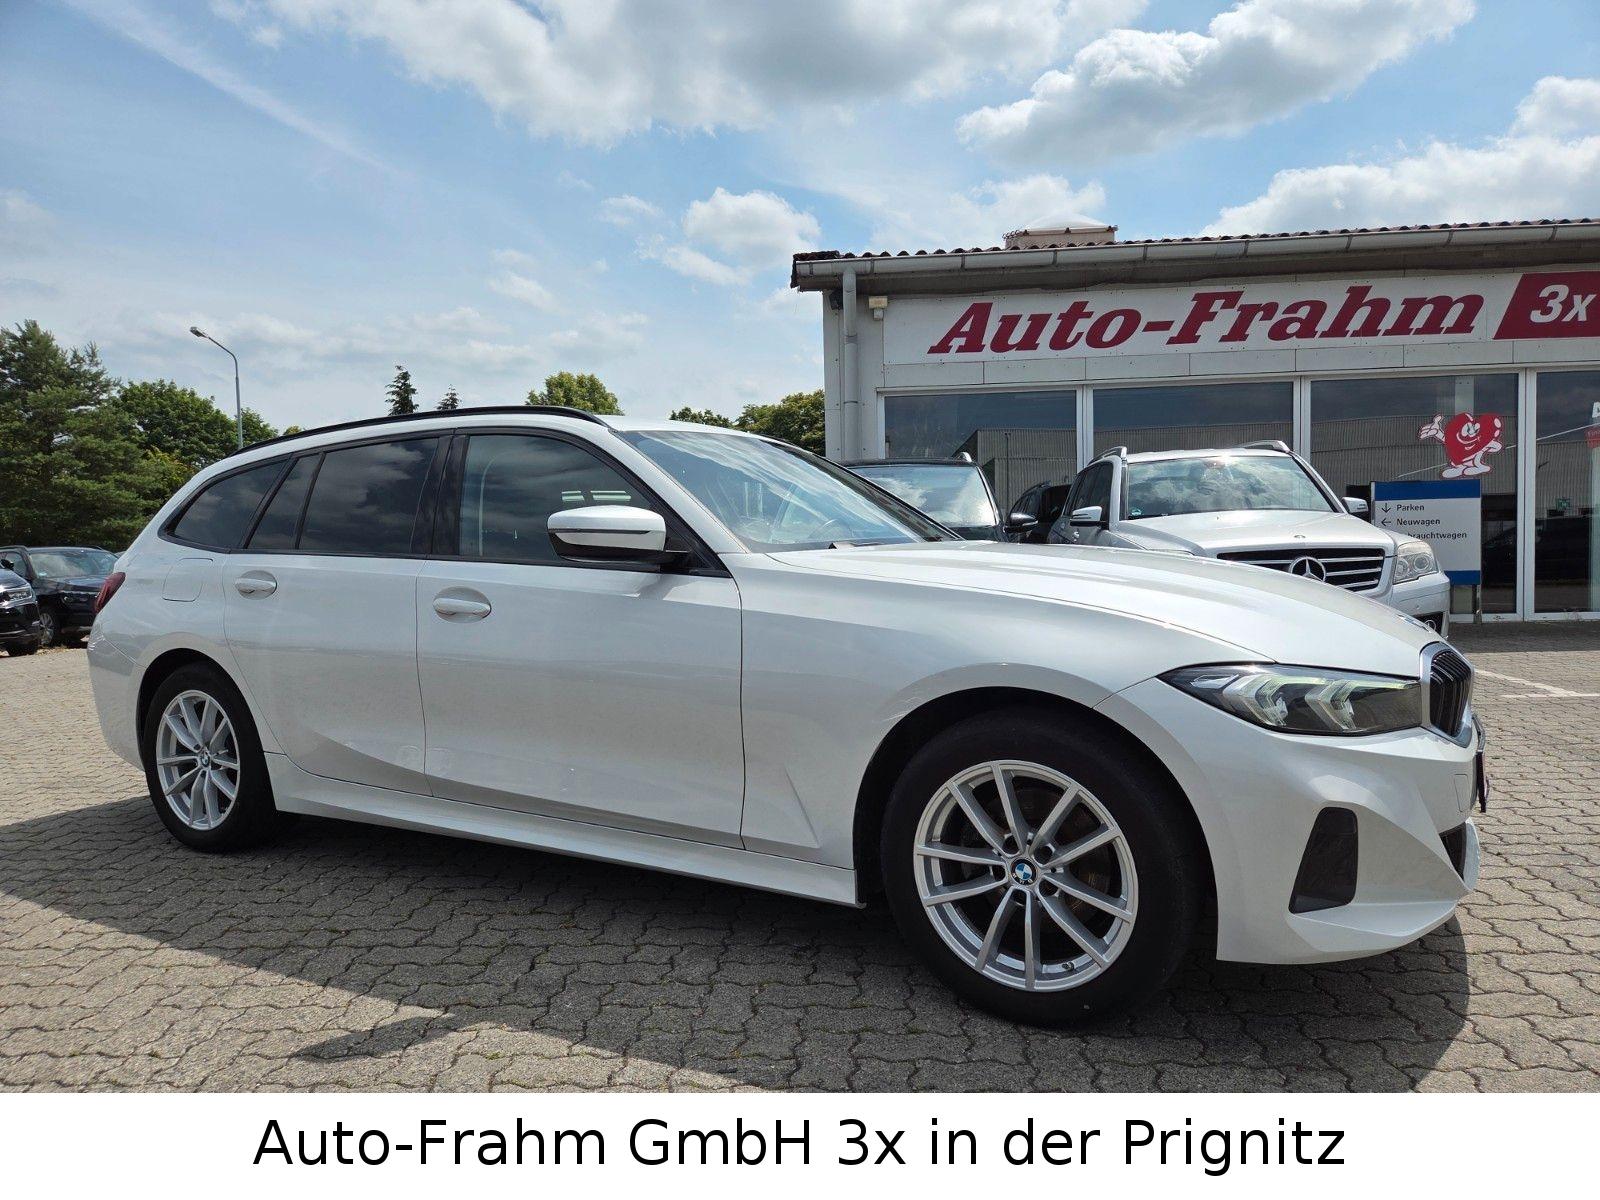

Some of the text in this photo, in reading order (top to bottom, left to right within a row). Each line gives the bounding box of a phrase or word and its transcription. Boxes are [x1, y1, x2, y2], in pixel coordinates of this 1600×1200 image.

[1530, 284, 1597, 323] 3x
[926, 285, 1485, 354] Auto-Frahm
[1396, 503, 1425, 512] Parken
[1396, 518, 1441, 527] Neuwagen
[1407, 531, 1467, 540] brauchtwagen
